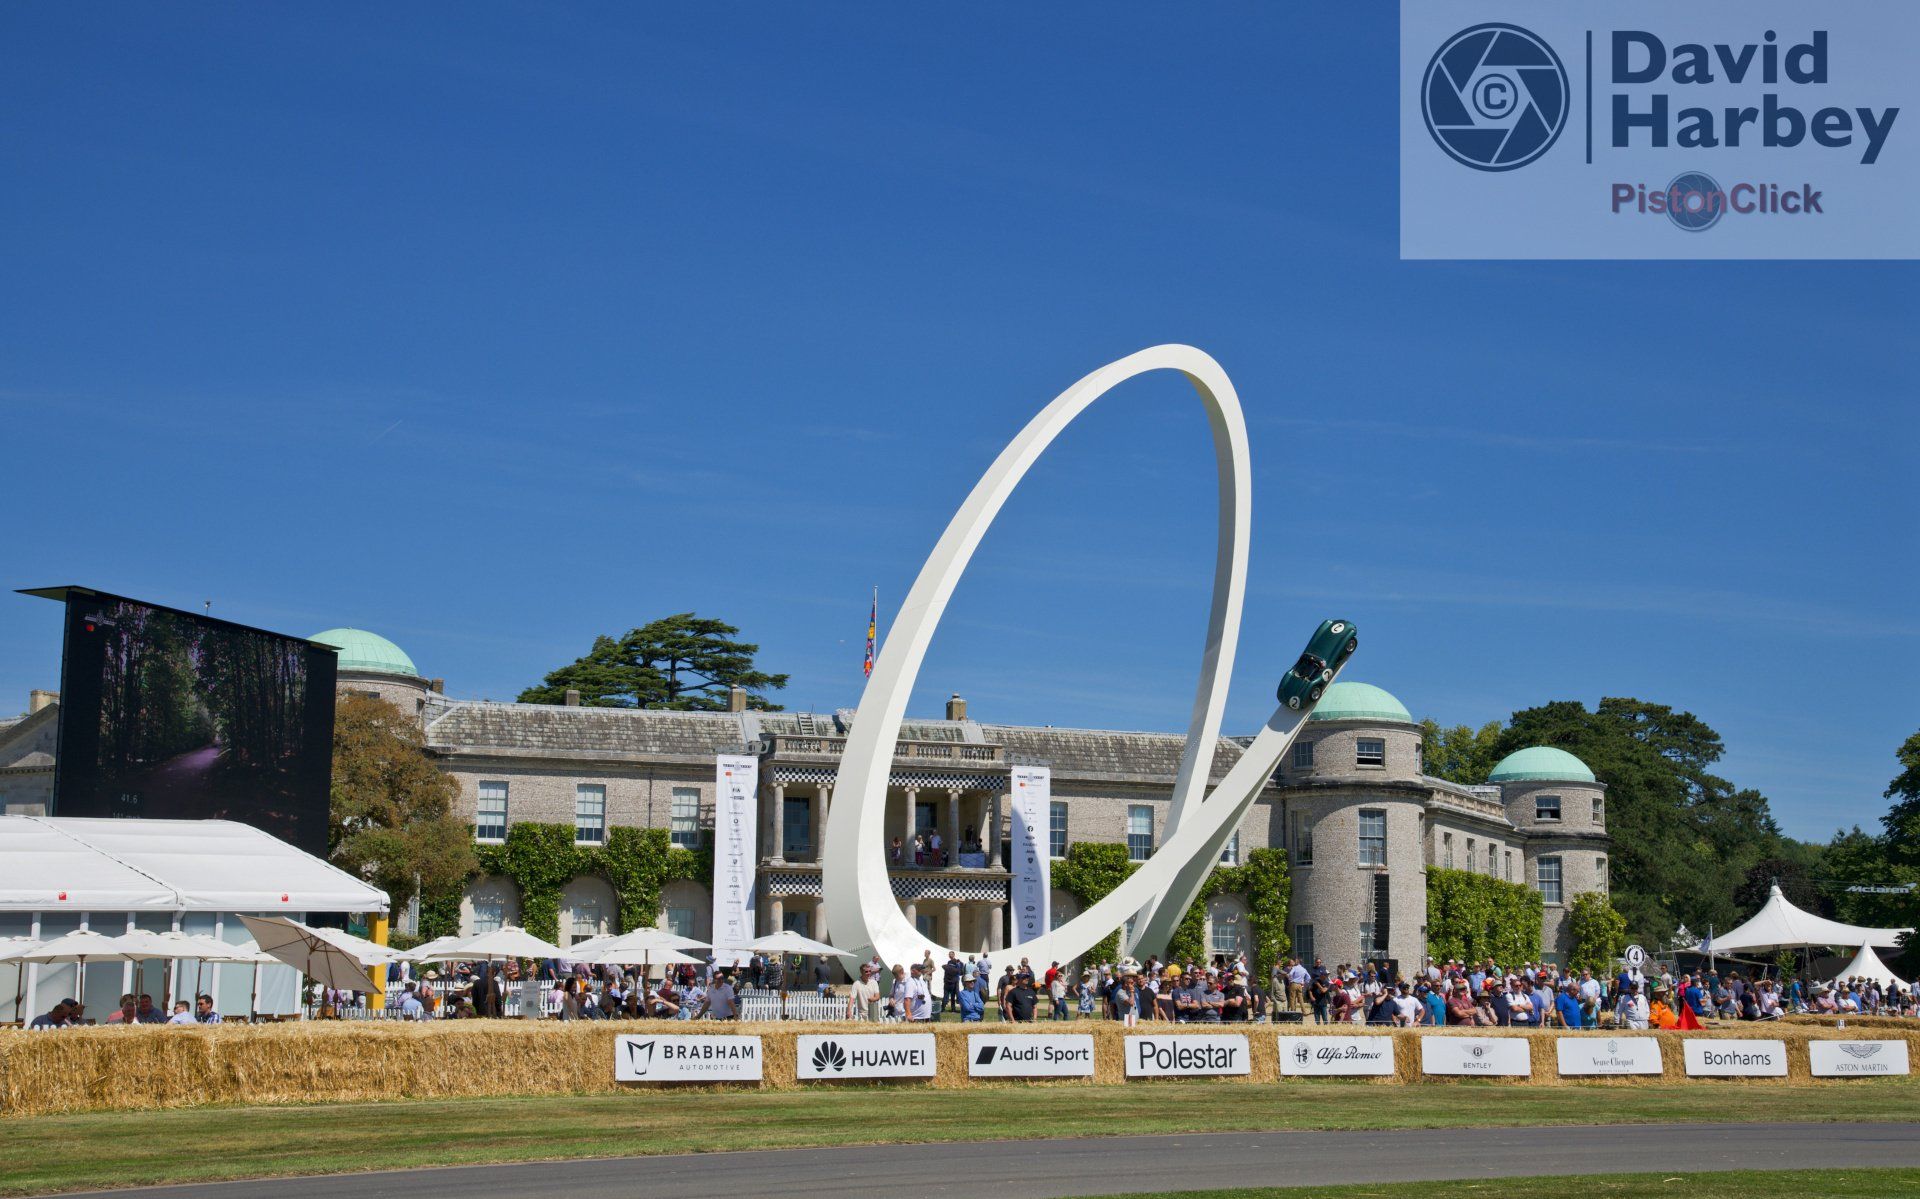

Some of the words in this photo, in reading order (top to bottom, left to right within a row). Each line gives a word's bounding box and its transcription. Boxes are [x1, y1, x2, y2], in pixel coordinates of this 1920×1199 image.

[1844, 885, 1910, 894] McLaren
[1632, 950, 1639, 962] 4
[663, 1045, 754, 1060] BRABHAM
[851, 1049, 925, 1067] HUAWEI
[999, 1046, 1039, 1061] Audi
[1043, 1045, 1089, 1065] Sport
[1139, 1041, 1238, 1070] Polestar
[1316, 1047, 1342, 1065] Alfa
[1345, 1045, 1382, 1060] Romeo
[1703, 1050, 1772, 1066] Bonhams
[1836, 1063, 1858, 1072] ASTON
[1860, 1063, 1888, 1072] MARTIN
